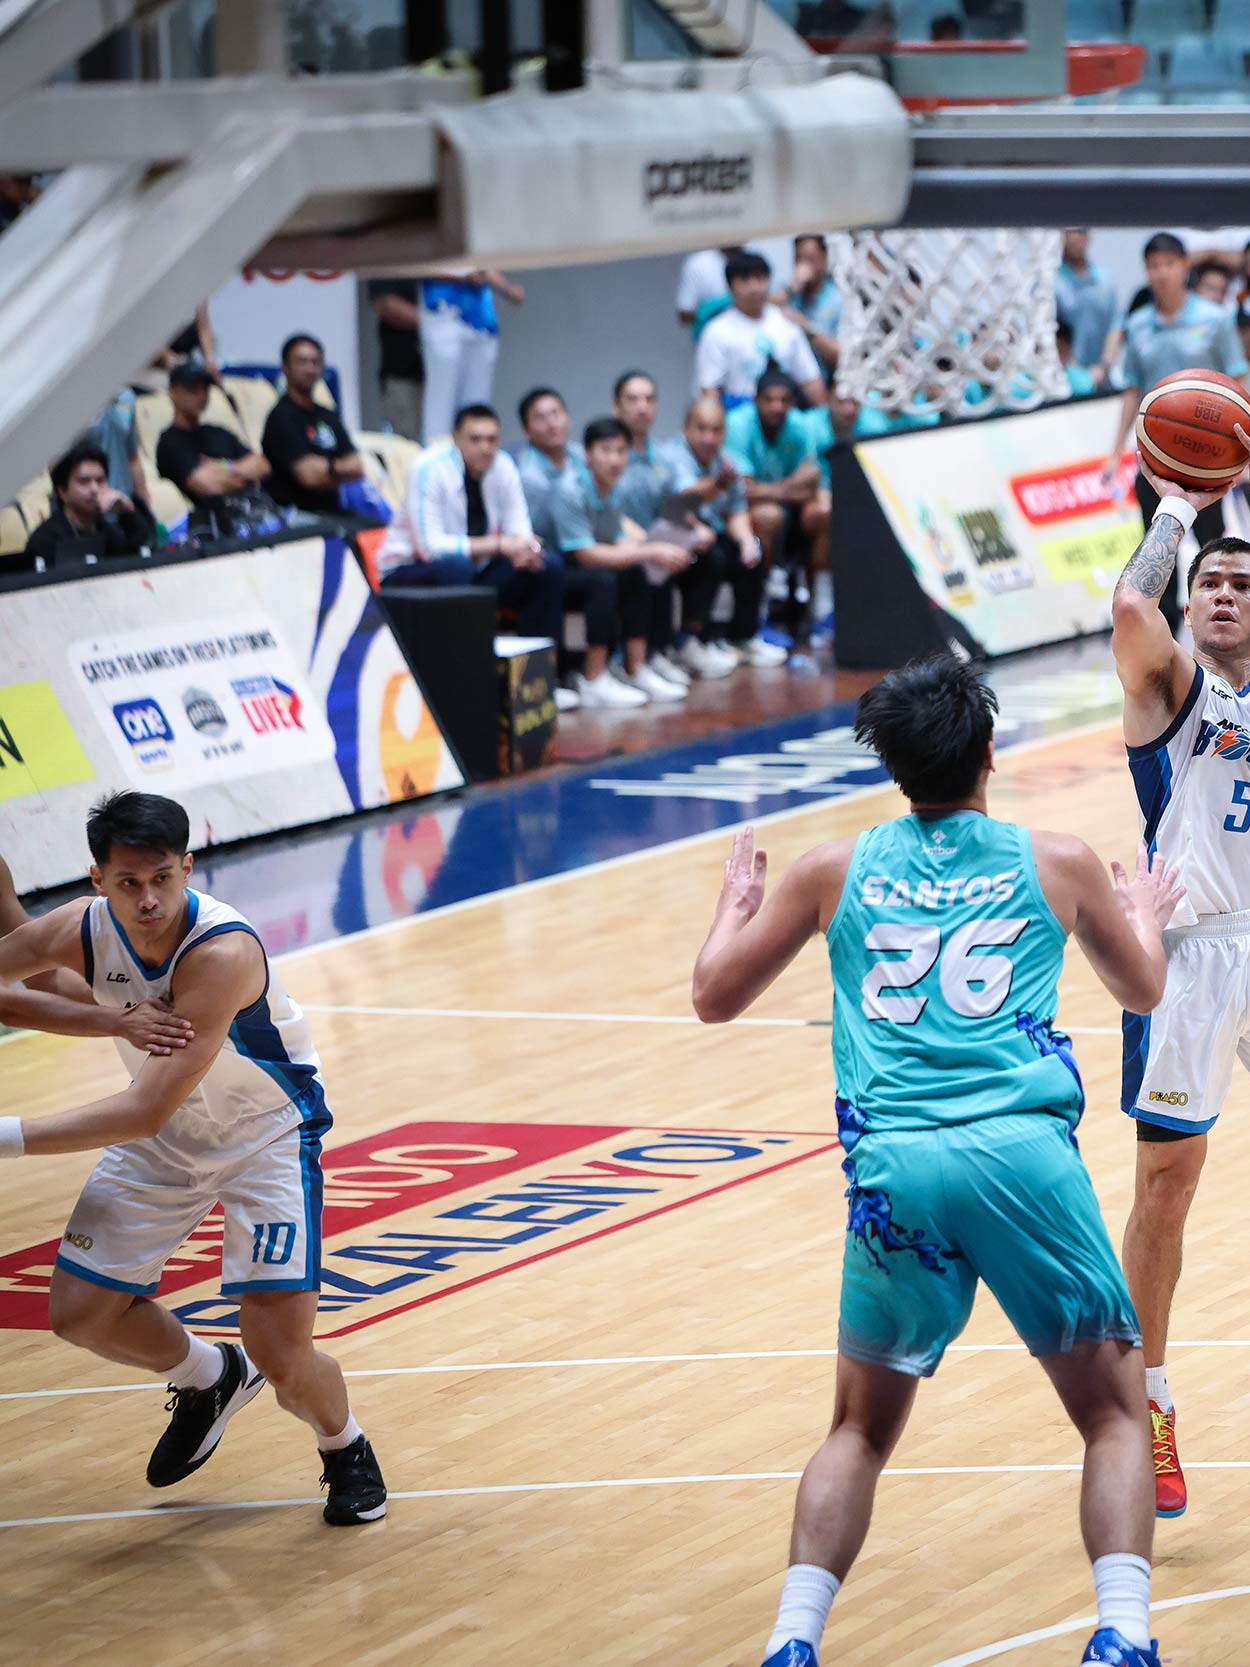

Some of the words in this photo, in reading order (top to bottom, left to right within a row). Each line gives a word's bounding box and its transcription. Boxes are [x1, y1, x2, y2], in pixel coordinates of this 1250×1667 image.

[1194, 405, 1222, 424] FIBA
[1173, 433, 1226, 459] molten
[81, 658, 121, 684] CATCH
[116, 652, 142, 676] THE
[136, 646, 176, 673] GAMES
[170, 644, 190, 665] ON
[185, 639, 220, 663] THESE
[122, 706, 168, 741] one
[241, 696, 292, 736] LIVE
[861, 871, 1019, 908] SANTOS
[861, 917, 1031, 1025] 26
[252, 1222, 297, 1265] 10
